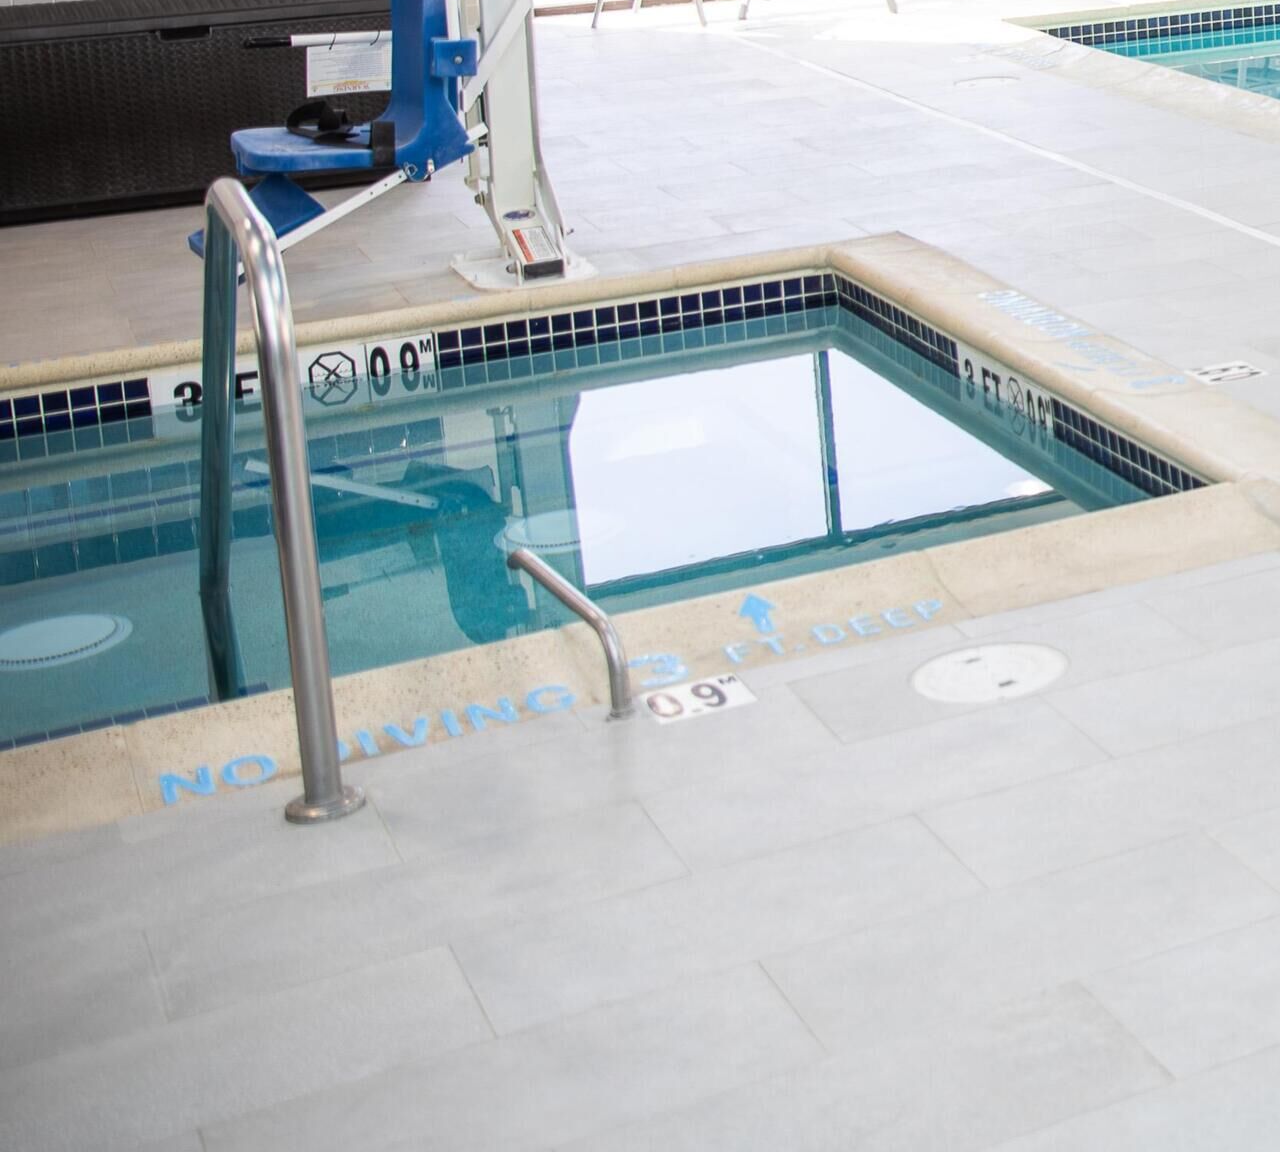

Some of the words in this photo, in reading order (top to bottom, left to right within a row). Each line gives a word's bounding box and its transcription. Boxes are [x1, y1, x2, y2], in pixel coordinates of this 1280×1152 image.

[158, 753, 279, 806] NO
[337, 683, 577, 763] IVING
[627, 652, 690, 688] 3
[811, 598, 944, 645] DEEP
